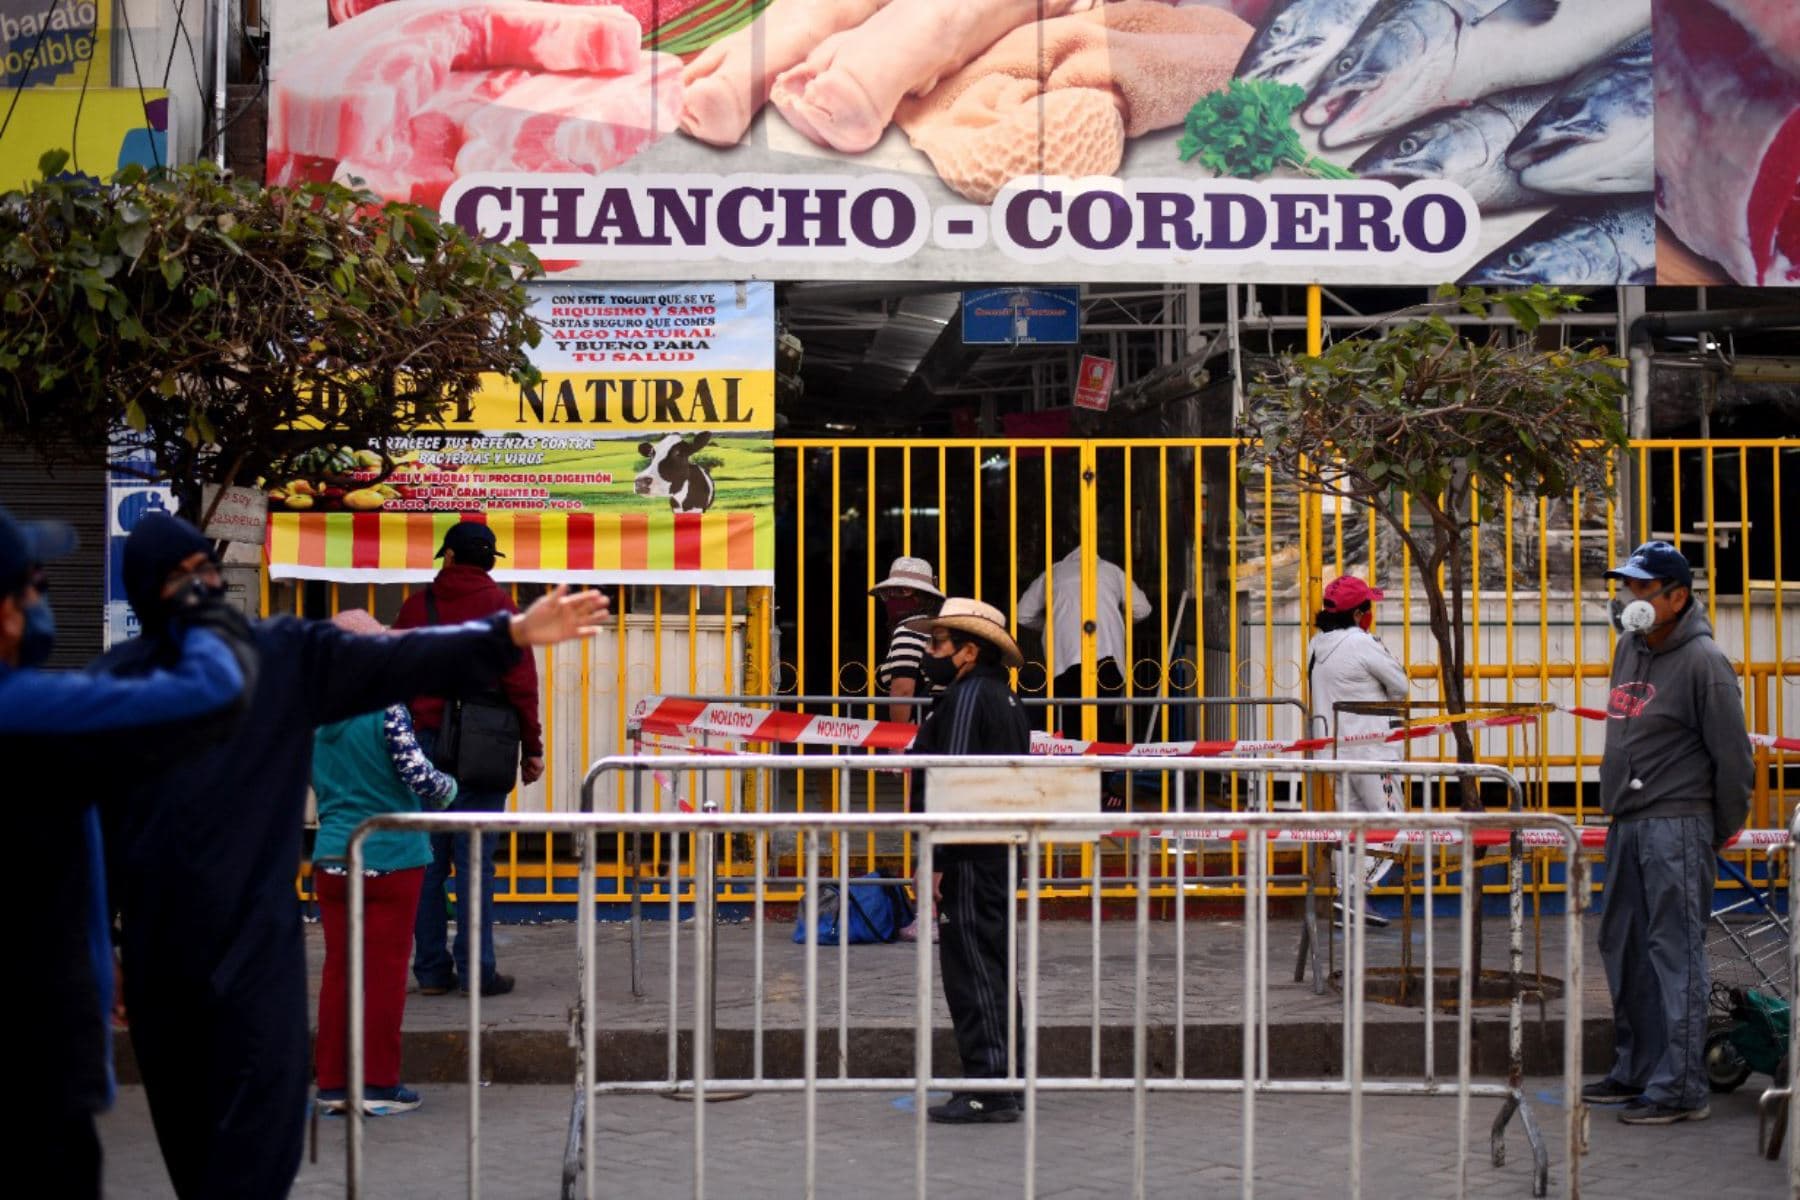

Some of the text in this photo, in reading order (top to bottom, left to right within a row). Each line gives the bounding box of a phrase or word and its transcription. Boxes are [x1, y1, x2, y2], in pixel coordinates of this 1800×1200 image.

[0, 1, 95, 43] barato
[454, 186, 916, 249] CHANCHO
[1005, 189, 1466, 253] CORDERO
[552, 294, 715, 306] CON ESTE YOGURT QUE SE VE
[552, 305, 716, 318] RIQUISIMO Y SANO
[552, 317, 715, 329] ESTAS SEGURO QUE COMES
[552, 328, 715, 339] ALGO NATURAL
[556, 340, 710, 351] Y BUENO PARA
[572, 352, 695, 362] TU SALUD
[516, 378, 753, 424] NATURAL
[445, 436, 468, 449] TUS
[471, 437, 537, 449] DEFENZAS
[420, 452, 544, 465] BACTERIAS Y VIRUS
[414, 472, 421, 483] Y
[423, 473, 469, 483] MEJORAS
[473, 474, 486, 483] TU
[488, 474, 537, 483] PROCESO
[539, 474, 553, 483] DE
[555, 472, 612, 483] DIGESTIÓN
[417, 487, 429, 498] ES
[431, 487, 454, 497] UNA
[457, 487, 487, 497] GRAN
[490, 488, 529, 497] FUENTE
[550, 501, 582, 510] YODO
[710, 709, 753, 728] CAUTION
[816, 719, 861, 740] CAUTION
